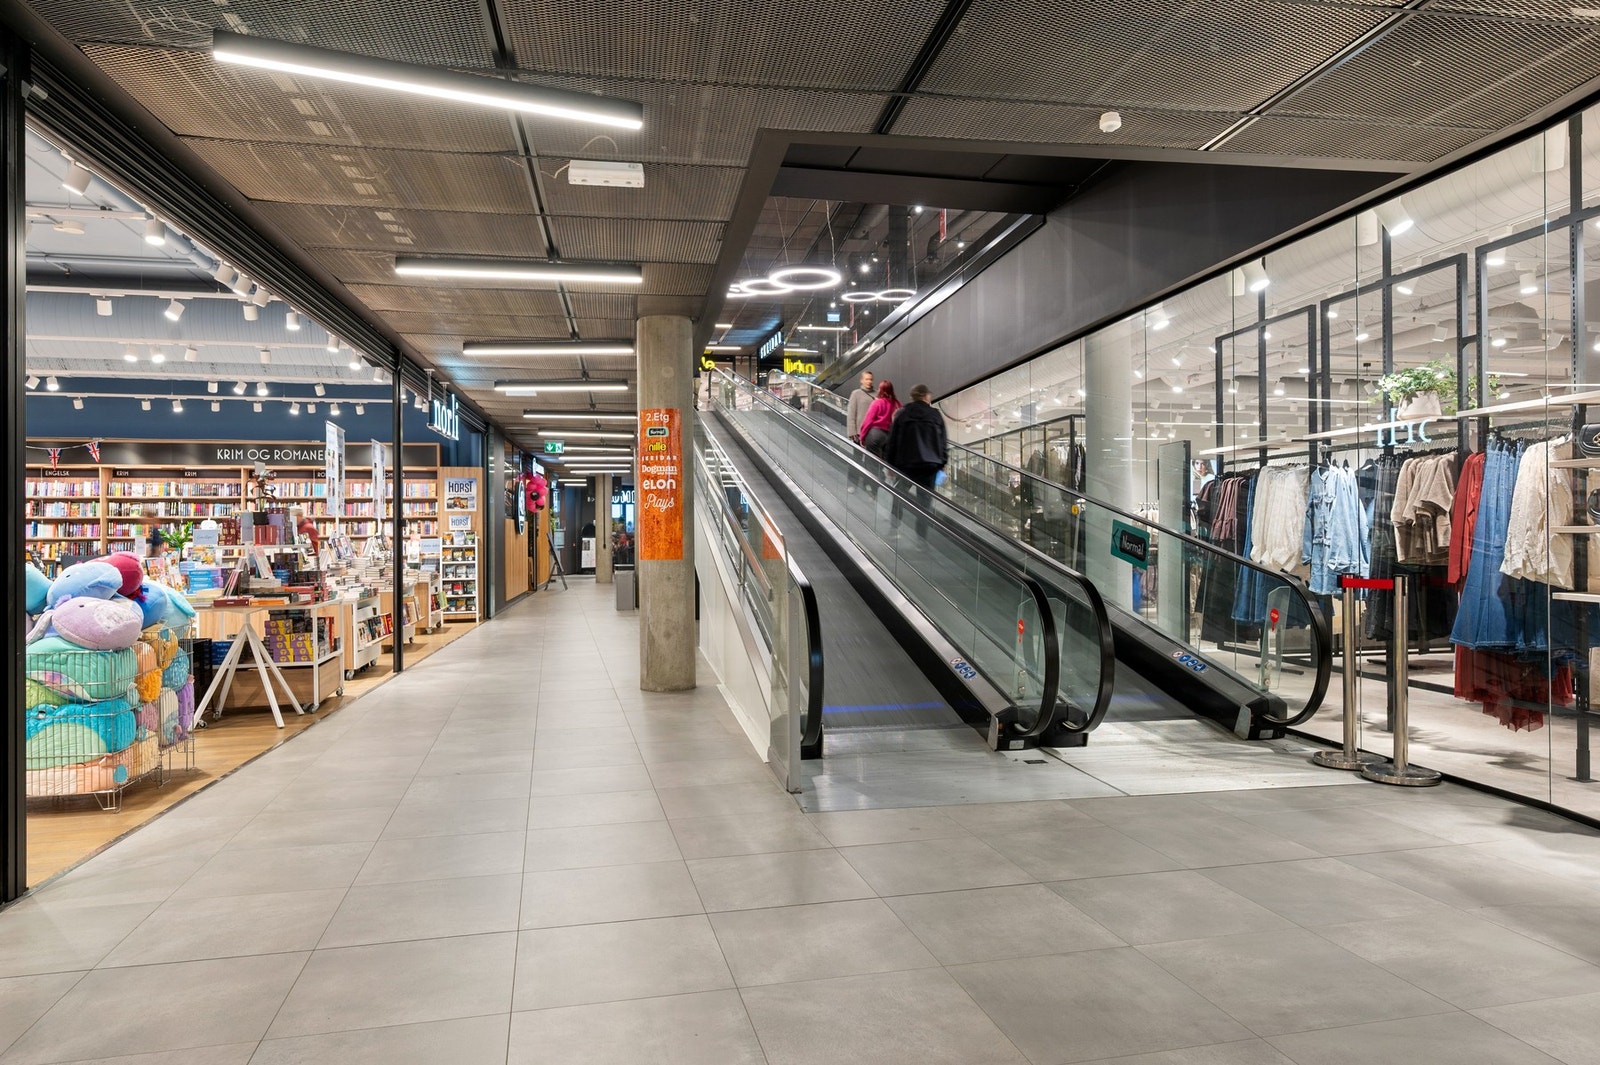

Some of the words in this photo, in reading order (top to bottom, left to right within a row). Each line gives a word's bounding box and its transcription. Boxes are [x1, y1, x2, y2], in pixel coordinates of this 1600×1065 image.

[433, 394, 460, 440] norli
[646, 412, 669, 423] 2.Etg
[649, 442, 666, 450] nille
[217, 449, 243, 461] KRIM
[247, 448, 271, 461] OG
[641, 464, 677, 475] Dogman
[448, 481, 473, 493] HORST
[644, 493, 675, 512] Plays
[451, 517, 469, 526] HORST
[1122, 534, 1144, 555] Normal
